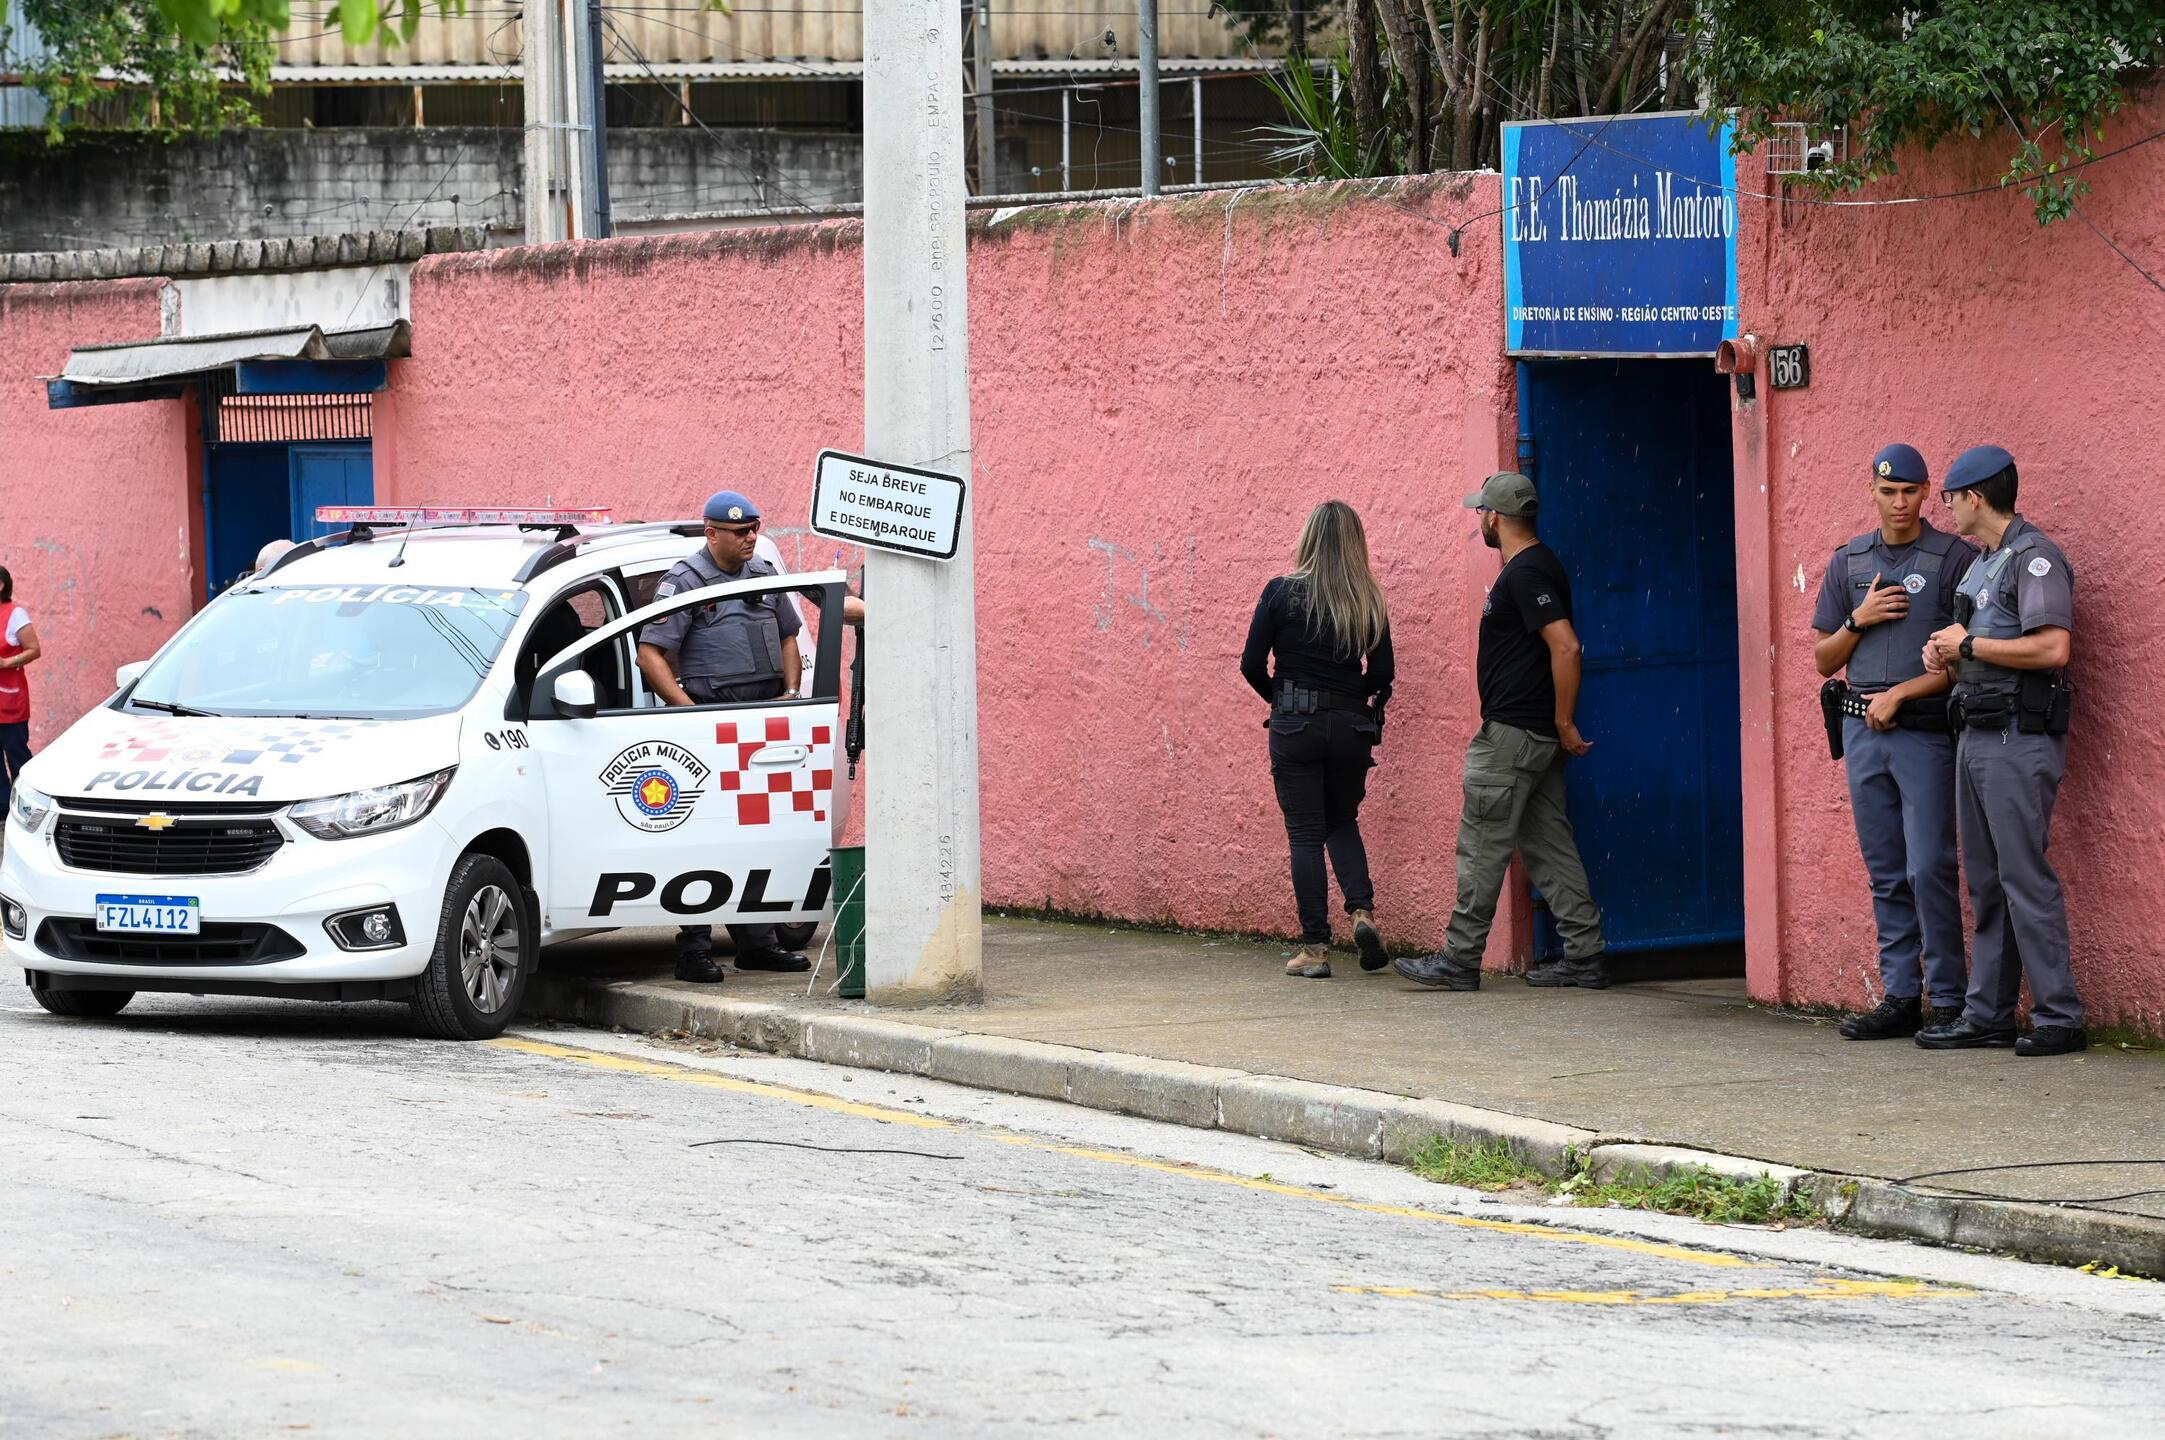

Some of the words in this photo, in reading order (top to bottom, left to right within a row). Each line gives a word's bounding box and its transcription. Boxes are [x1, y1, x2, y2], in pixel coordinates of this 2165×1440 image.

[1510, 176, 1547, 242] E.E.
[1558, 173, 1650, 241] Thomázia
[1655, 171, 1734, 239] Montoro
[1513, 306, 1561, 321] DIRETORIA
[1563, 307, 1576, 321] DE
[1579, 305, 1614, 321] ENSINO
[1621, 304, 1658, 321] REGIÃO
[1769, 348, 1802, 386] 156
[849, 469, 879, 486] SEJA
[882, 475, 927, 495] BREVE
[839, 490, 856, 503] NO
[858, 494, 932, 519] EMBARQUE
[830, 511, 838, 522] E
[840, 513, 937, 542] DESEMBARQUE
[272, 584, 465, 608] POLÍCIA
[500, 728, 529, 749] 190
[605, 745, 651, 782] POLÍCIA
[656, 745, 703, 778] MILITAR
[83, 766, 264, 797] POLÍCIA
[654, 820, 675, 830] PAULO
[106, 906, 189, 930] FZL4I12
